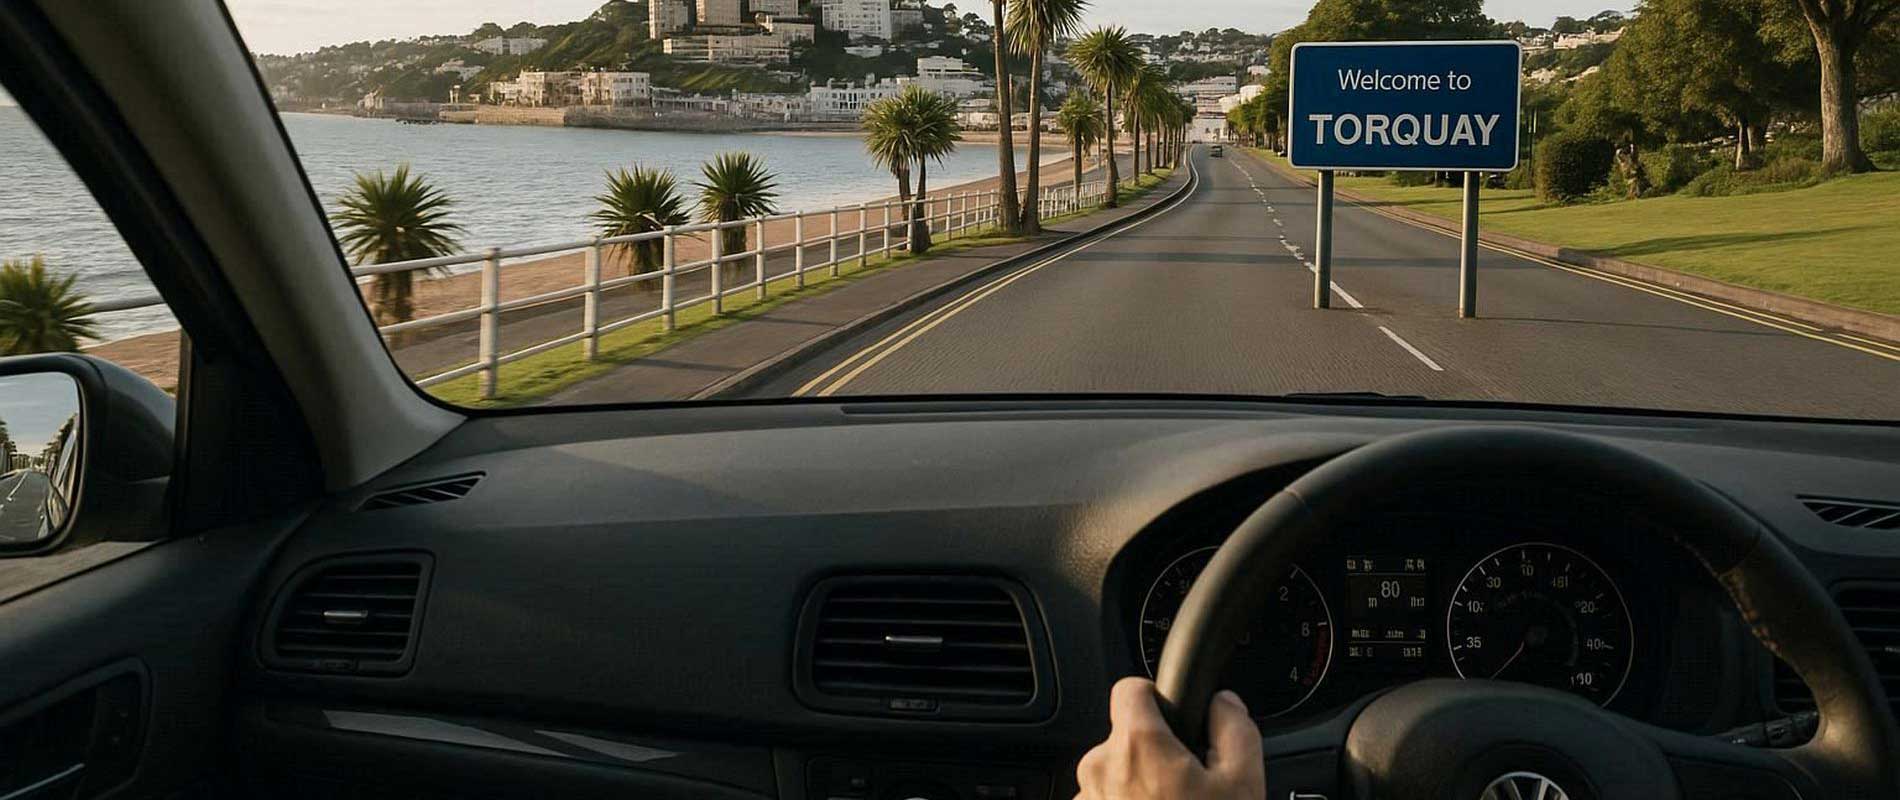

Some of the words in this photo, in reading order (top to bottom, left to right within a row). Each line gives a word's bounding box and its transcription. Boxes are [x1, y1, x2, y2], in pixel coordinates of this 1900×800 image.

[1338, 69, 1441, 90] Welcome
[1448, 71, 1471, 90] to
[1309, 114, 1500, 146] TORQUAY
[1280, 586, 1289, 601] 2
[1381, 580, 1400, 598] 80
[1466, 636, 1481, 648] 35
